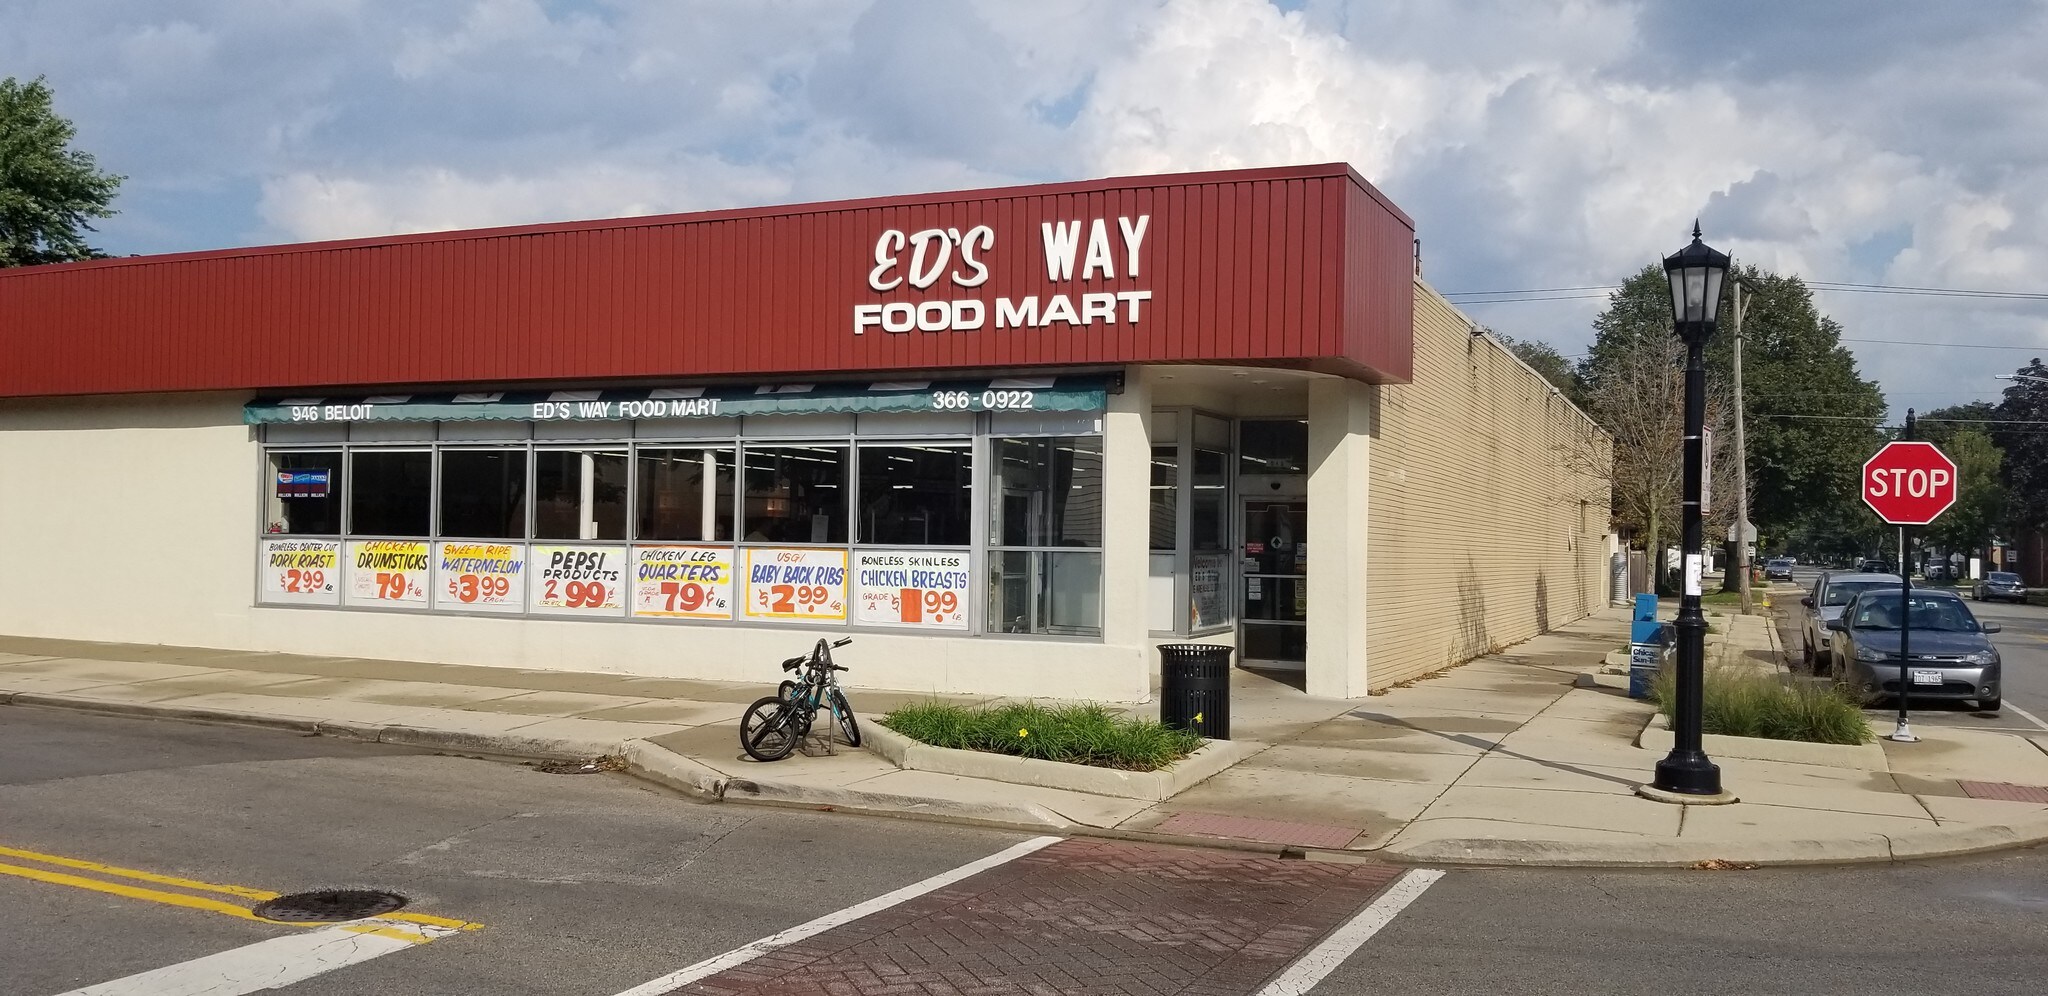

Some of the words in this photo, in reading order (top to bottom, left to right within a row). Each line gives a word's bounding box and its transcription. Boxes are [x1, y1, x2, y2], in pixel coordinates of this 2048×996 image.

[868, 225, 995, 291] ED'S
[1041, 215, 1150, 282] WAY
[854, 299, 986, 335] FOOD
[995, 290, 1152, 329] MART
[292, 406, 318, 421] 946
[325, 404, 373, 420] BELOIT
[533, 402, 570, 419] ED'S
[578, 402, 611, 418] WAY
[619, 400, 667, 417] FOOD
[670, 398, 721, 416] MART
[1869, 468, 1949, 498] STOP
[269, 543, 298, 551] BONELESS
[300, 543, 323, 551] CENTER
[324, 543, 338, 551] CUT
[365, 541, 420, 551] CHICKEN
[443, 544, 482, 554] SWEET
[485, 545, 512, 555] RIPE
[269, 554, 297, 568] PORK
[297, 554, 334, 568] ROAST
[357, 553, 428, 570] DRUMSTICKS
[551, 551, 606, 570] PEPSI
[640, 550, 687, 561] CHICKEN
[690, 551, 716, 562] LEG
[861, 556, 904, 566] BONELESS
[908, 557, 960, 566] SKINLESS
[441, 557, 523, 574] WATERMELON
[638, 563, 721, 581] QUARTERS
[543, 569, 619, 581] PRODUCTS
[751, 564, 781, 583] BABY
[782, 565, 815, 585] BACK
[814, 566, 845, 586] RIBS
[861, 569, 907, 587] CHICKEN
[911, 570, 967, 589] BREASTS
[544, 580, 558, 600] 2
[862, 592, 889, 600] GRADE
[868, 602, 877, 610] A
